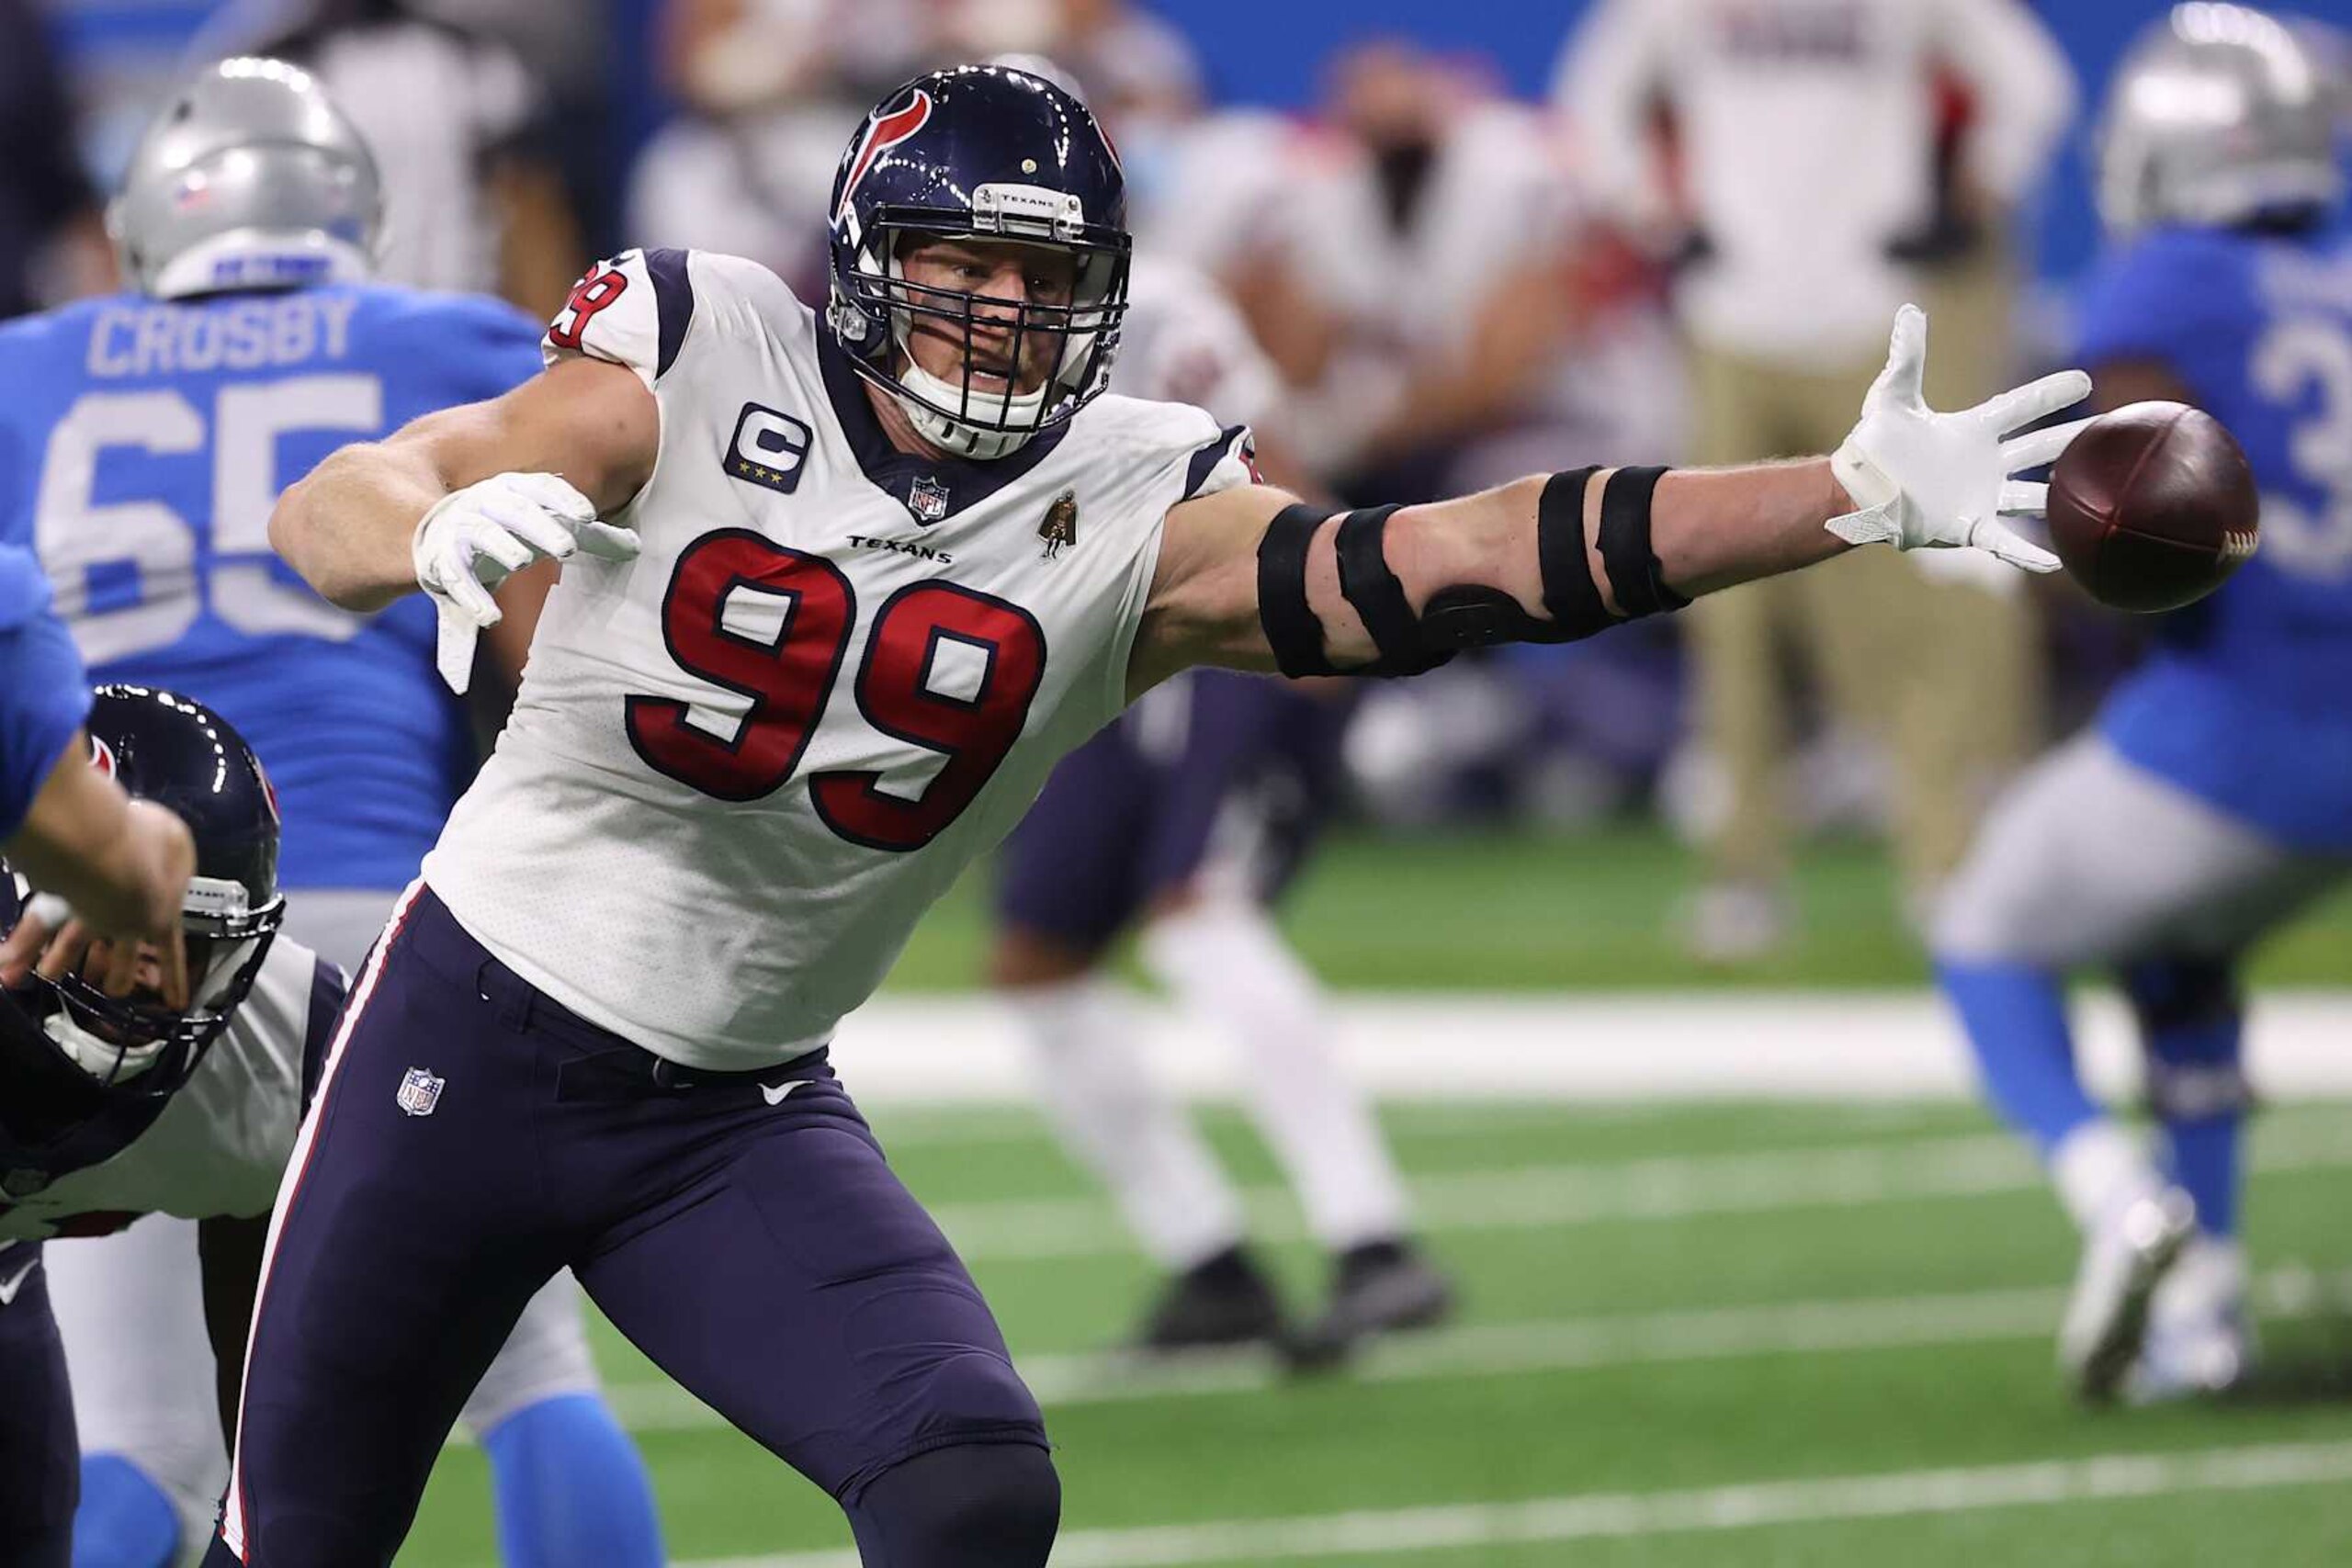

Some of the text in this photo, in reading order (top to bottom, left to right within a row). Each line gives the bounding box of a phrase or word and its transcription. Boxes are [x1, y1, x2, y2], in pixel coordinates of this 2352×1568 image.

[1001, 194, 1054, 208] TEXANS
[86, 298, 357, 378] CROSBY
[737, 411, 806, 472] C
[35, 373, 382, 667] 65
[846, 535, 953, 564] TEXANS
[625, 527, 1047, 853] 99
